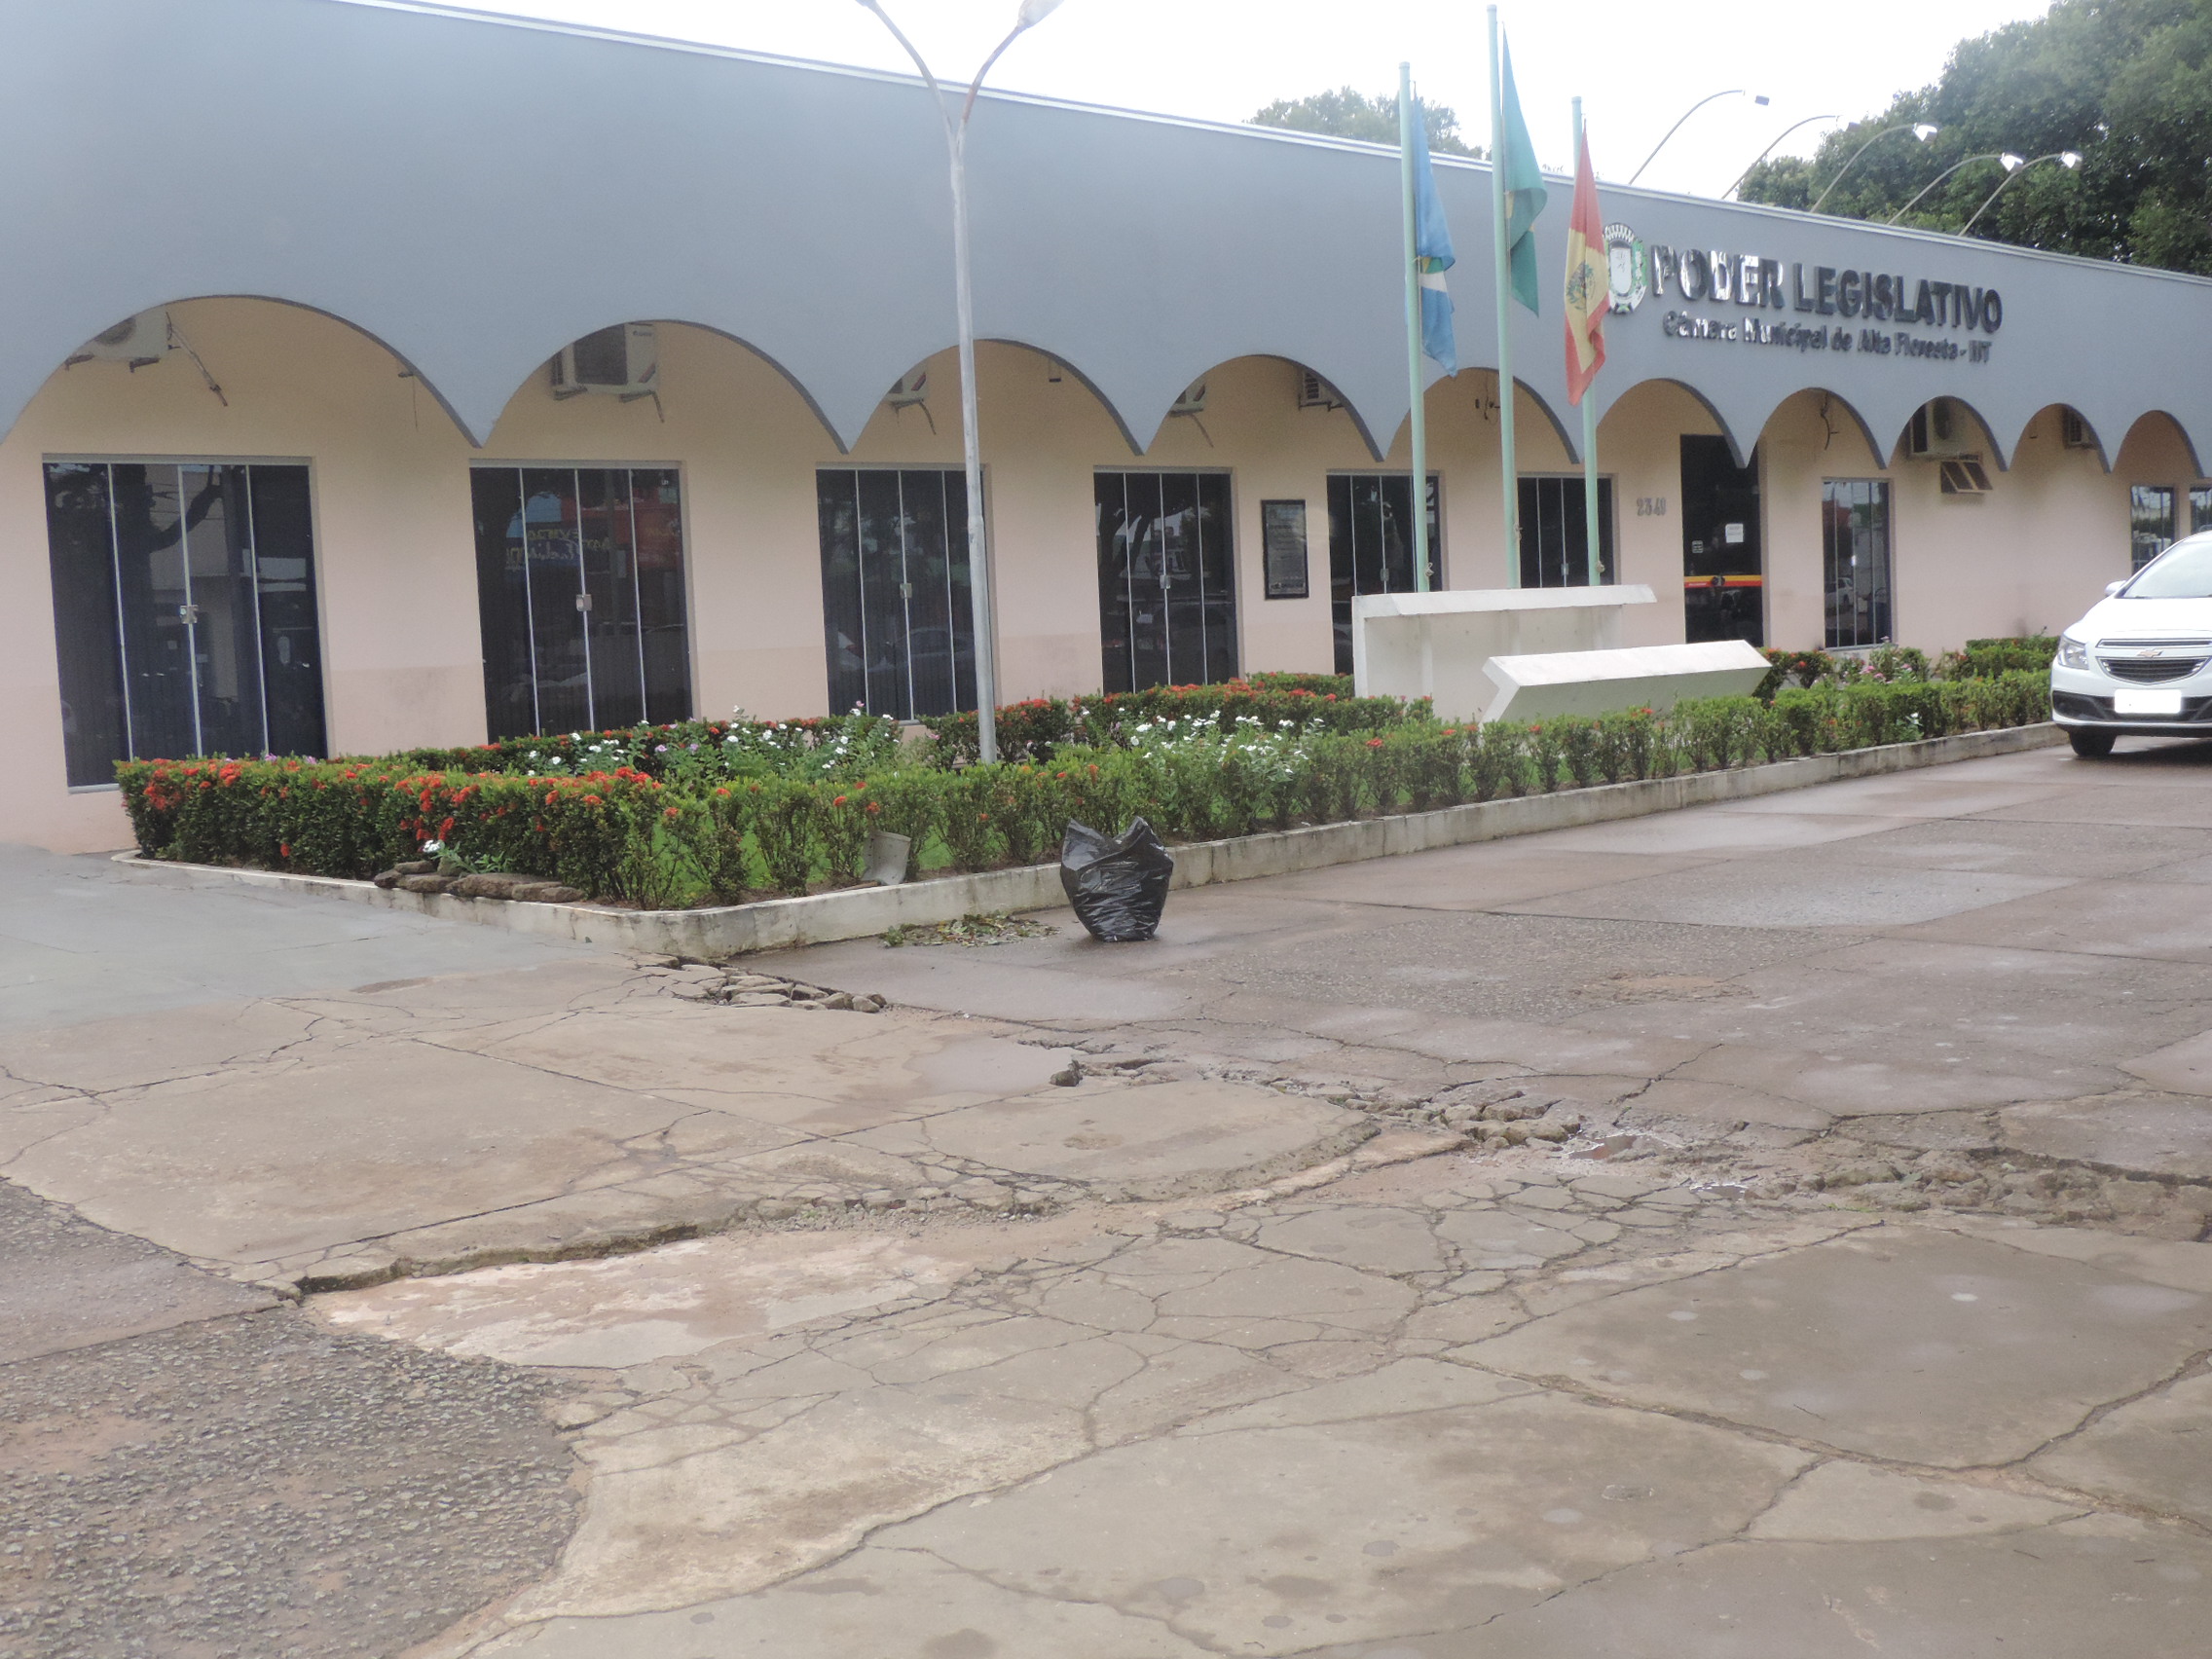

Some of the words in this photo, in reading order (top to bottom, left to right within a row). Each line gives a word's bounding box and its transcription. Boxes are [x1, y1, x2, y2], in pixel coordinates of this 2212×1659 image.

[1651, 244, 1786, 310] PODER
[1793, 262, 2003, 334] LEGISLATIVO
[1743, 316, 1828, 353] Municipal
[1830, 325, 1853, 351] de
[1857, 328, 1892, 354] Alta
[1895, 333, 1959, 359] Floresta
